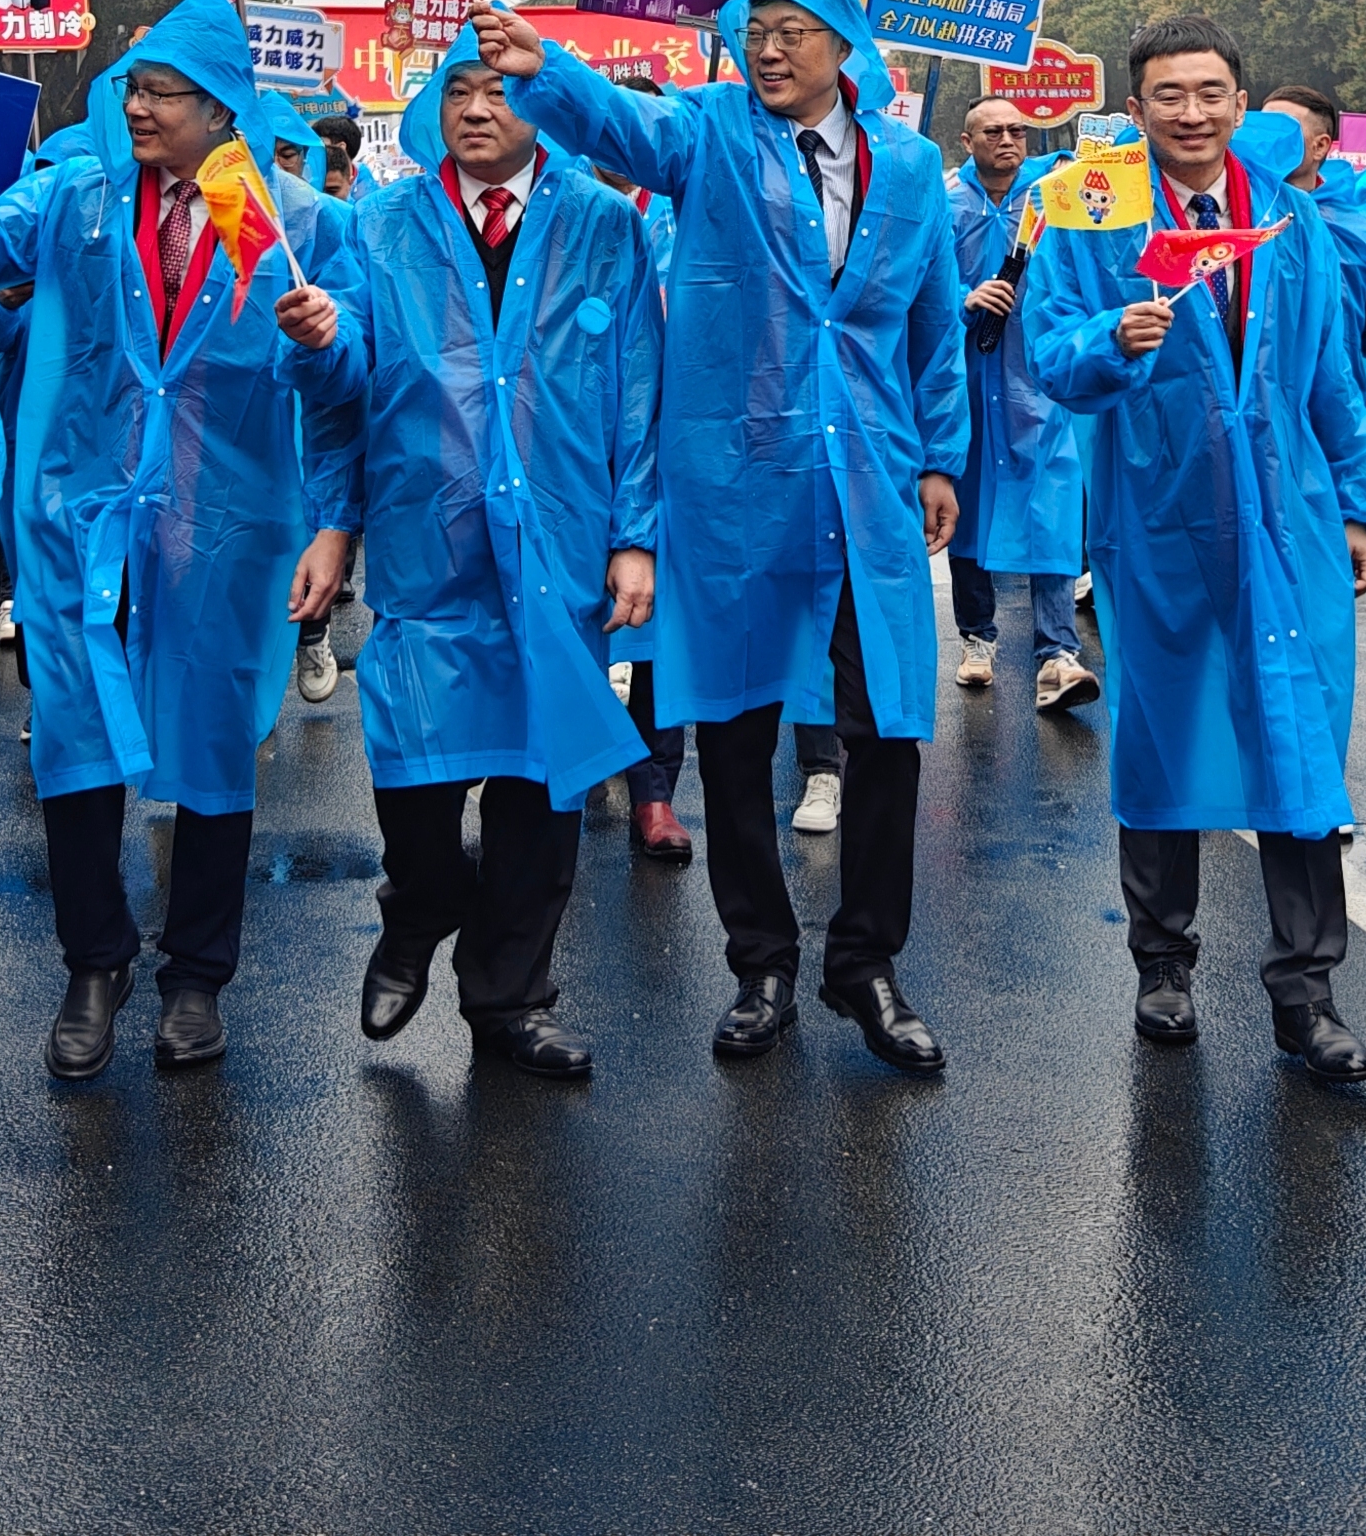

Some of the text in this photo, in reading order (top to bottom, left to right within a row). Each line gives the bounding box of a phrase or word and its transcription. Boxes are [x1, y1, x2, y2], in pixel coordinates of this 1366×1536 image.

[411, 19, 463, 42] 够威够
[877, 10, 1016, 53] 全力以赴拼经济
